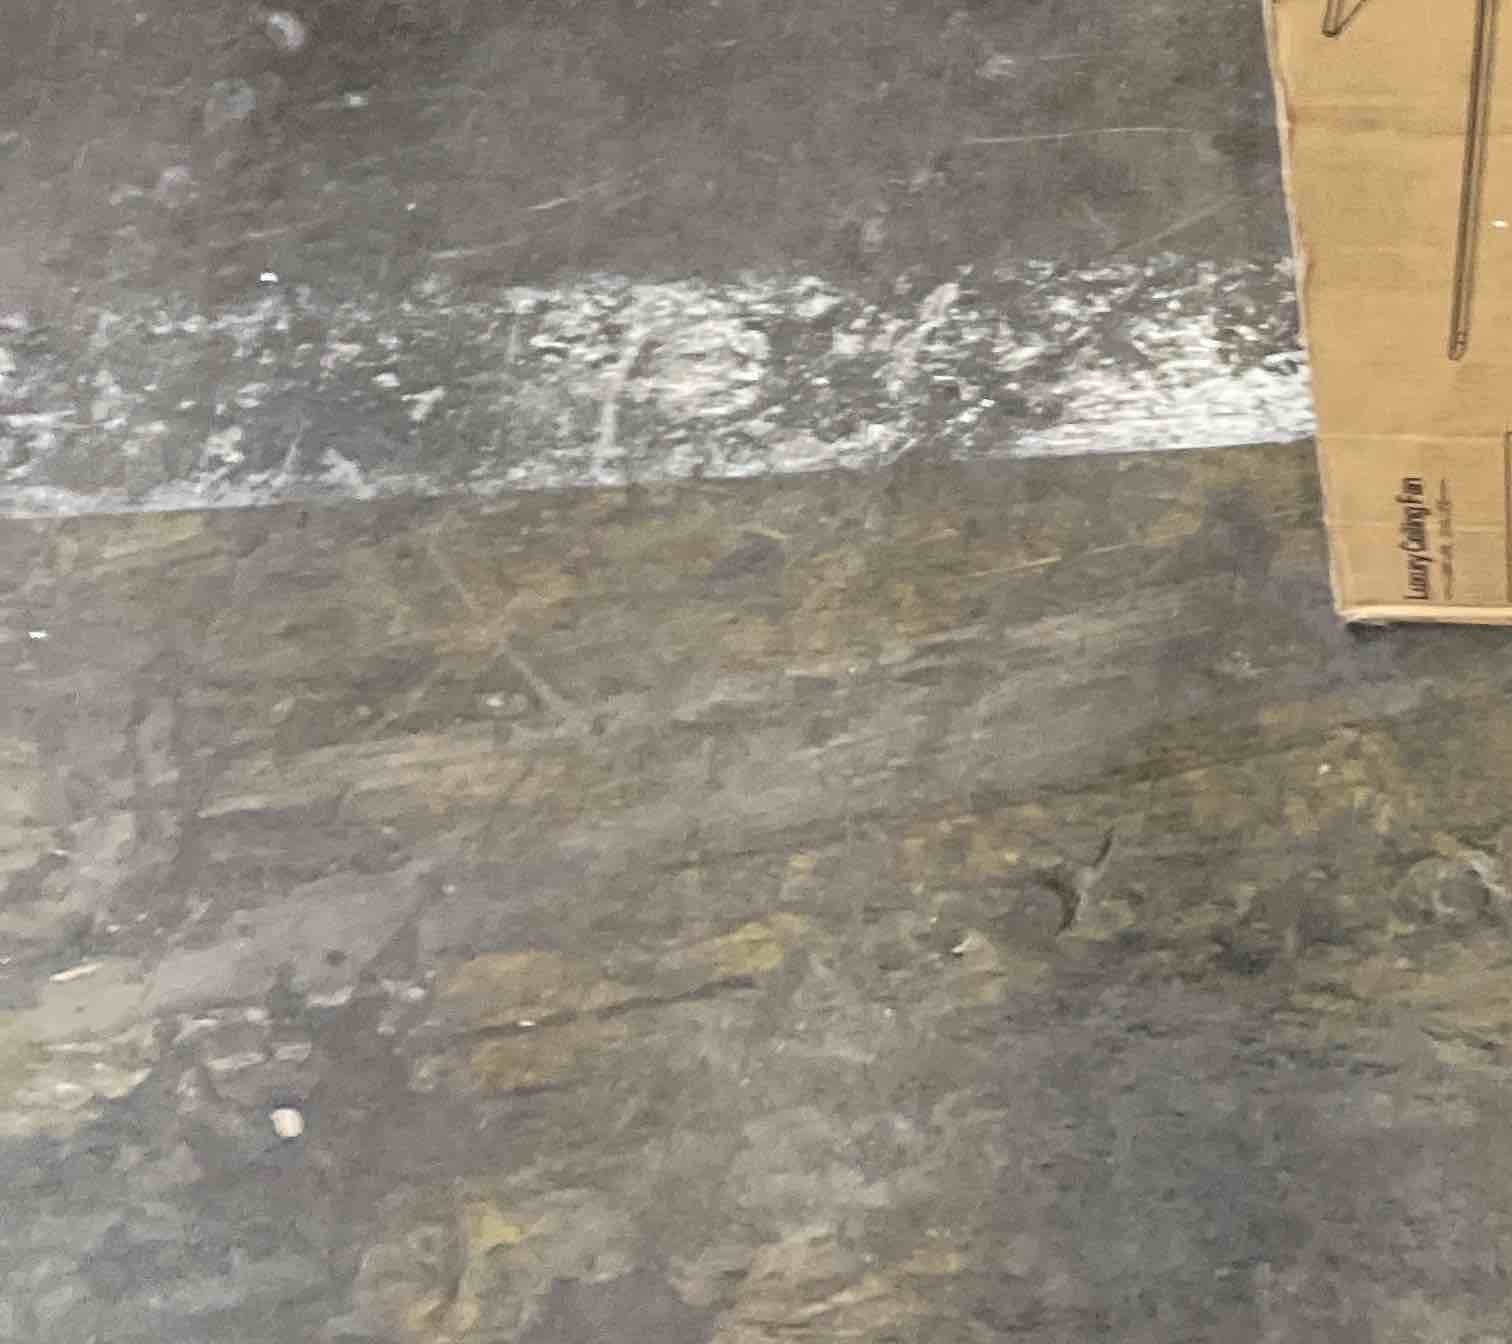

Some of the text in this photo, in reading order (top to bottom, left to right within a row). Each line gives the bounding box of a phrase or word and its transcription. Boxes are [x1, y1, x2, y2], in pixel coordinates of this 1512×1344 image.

[1395, 477, 1434, 600] Luxury Ceiling Fan
